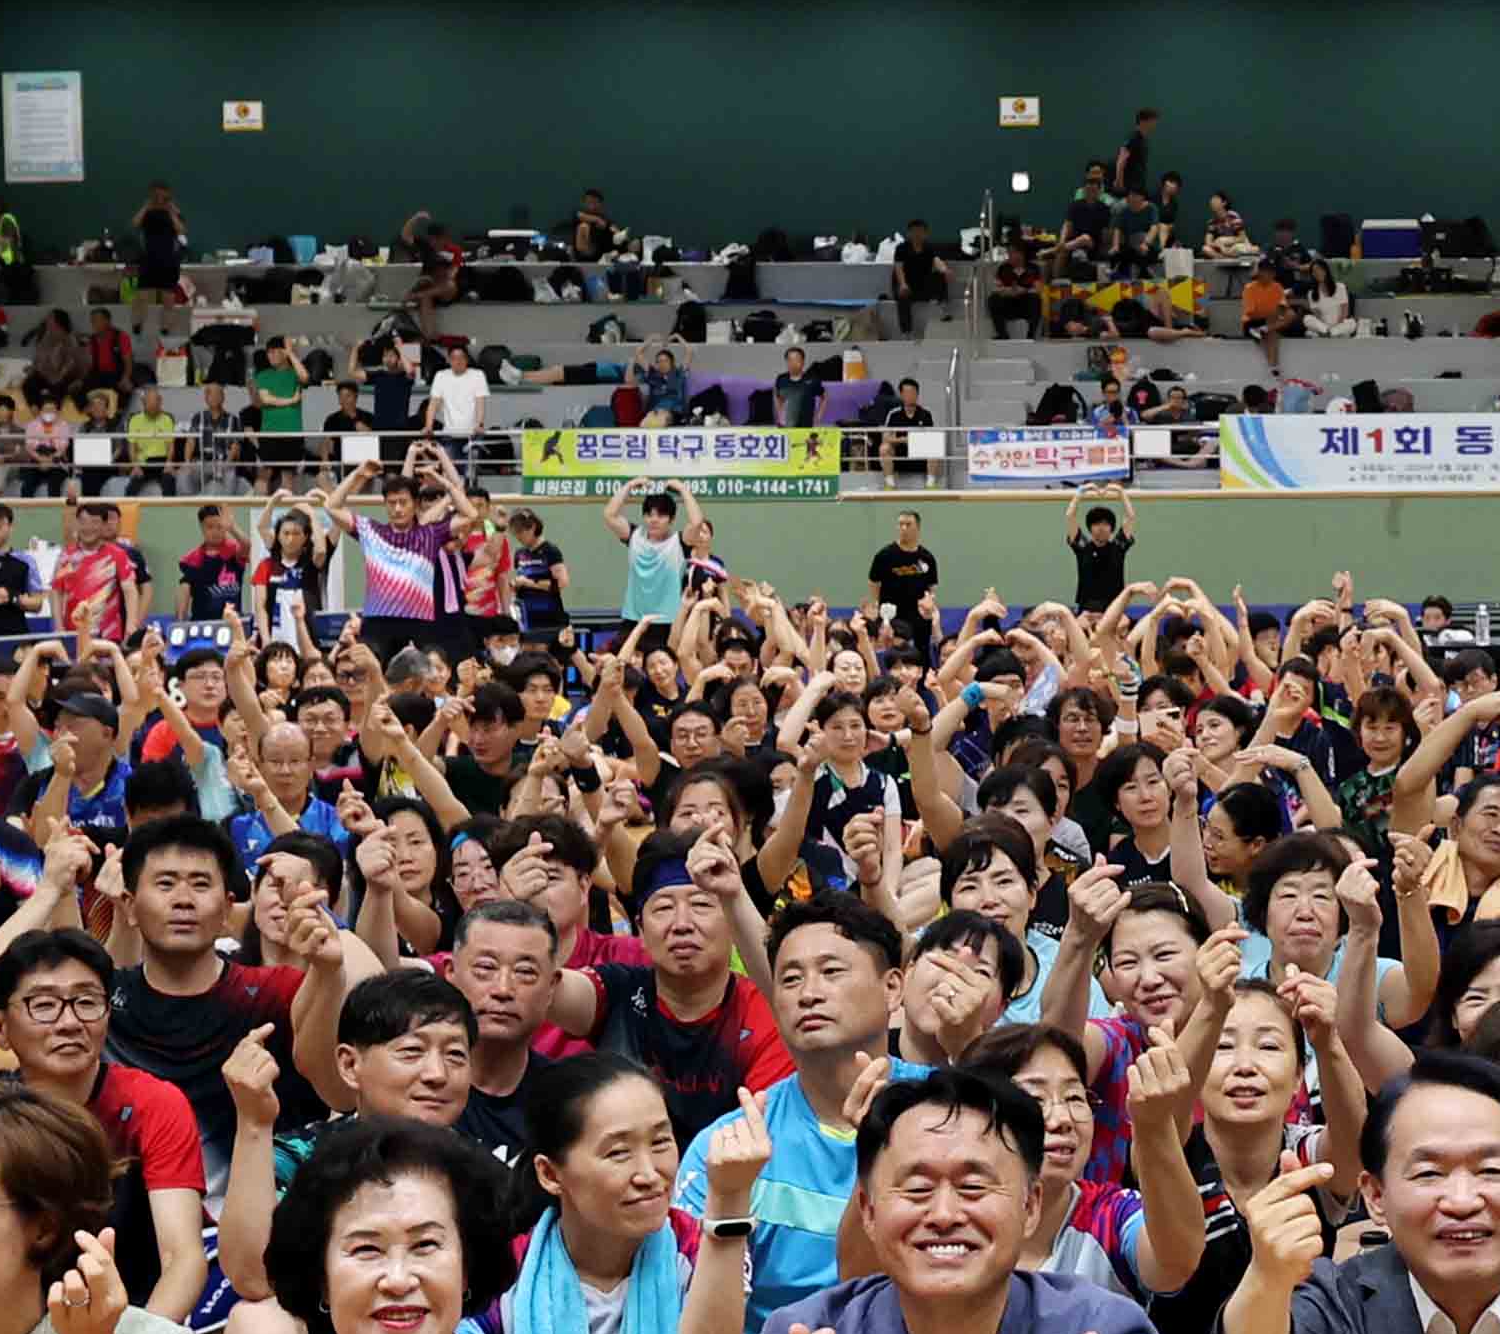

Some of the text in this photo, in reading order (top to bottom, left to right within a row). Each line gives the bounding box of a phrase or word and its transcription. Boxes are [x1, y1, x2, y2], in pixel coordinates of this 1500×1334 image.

[576, 433, 787, 460] 꿈드림 탁구 동호회
[1319, 426, 1432, 455] 제1회
[716, 478, 830, 495] 010-4144-1741
